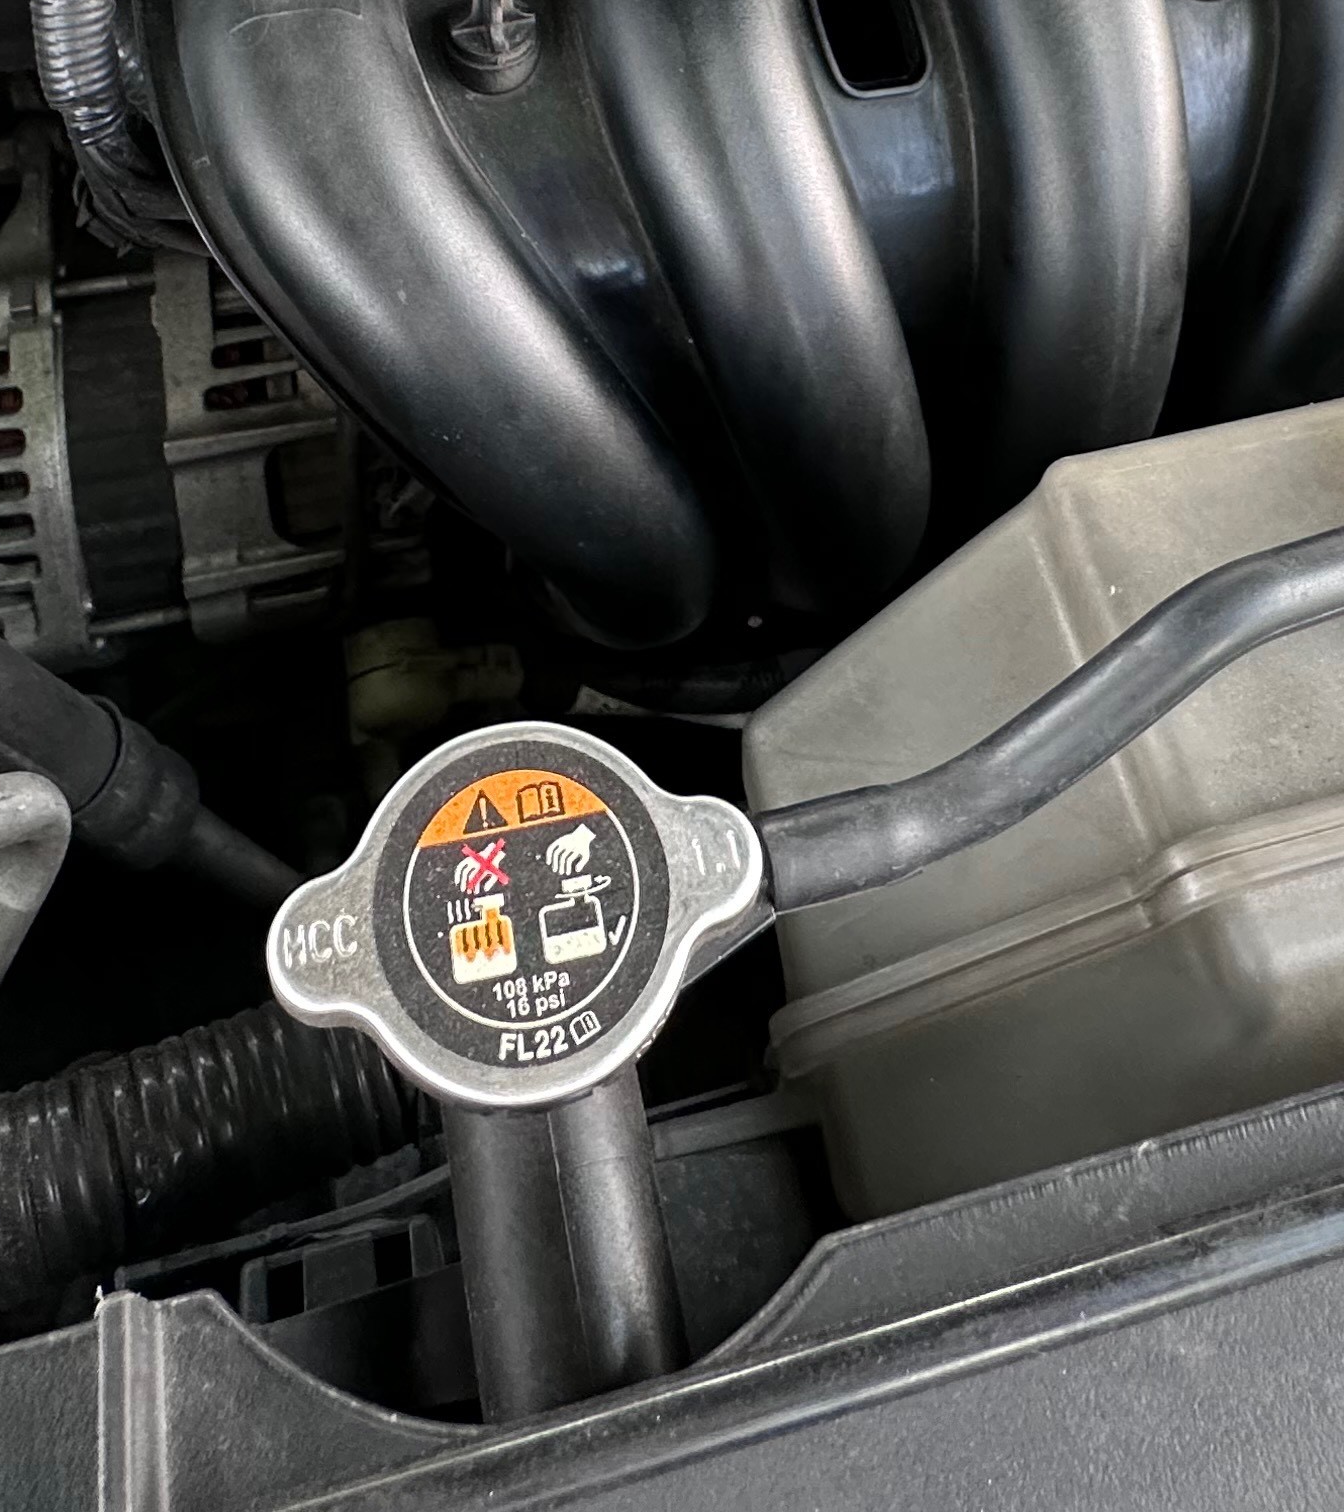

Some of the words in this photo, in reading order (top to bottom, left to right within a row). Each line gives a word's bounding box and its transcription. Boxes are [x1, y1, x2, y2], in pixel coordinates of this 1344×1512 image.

[492, 975, 528, 1002] 108
[532, 970, 571, 994] kPa
[506, 995, 531, 1019] 16
[535, 987, 566, 1018] psi
[498, 1024, 569, 1062] FL22
